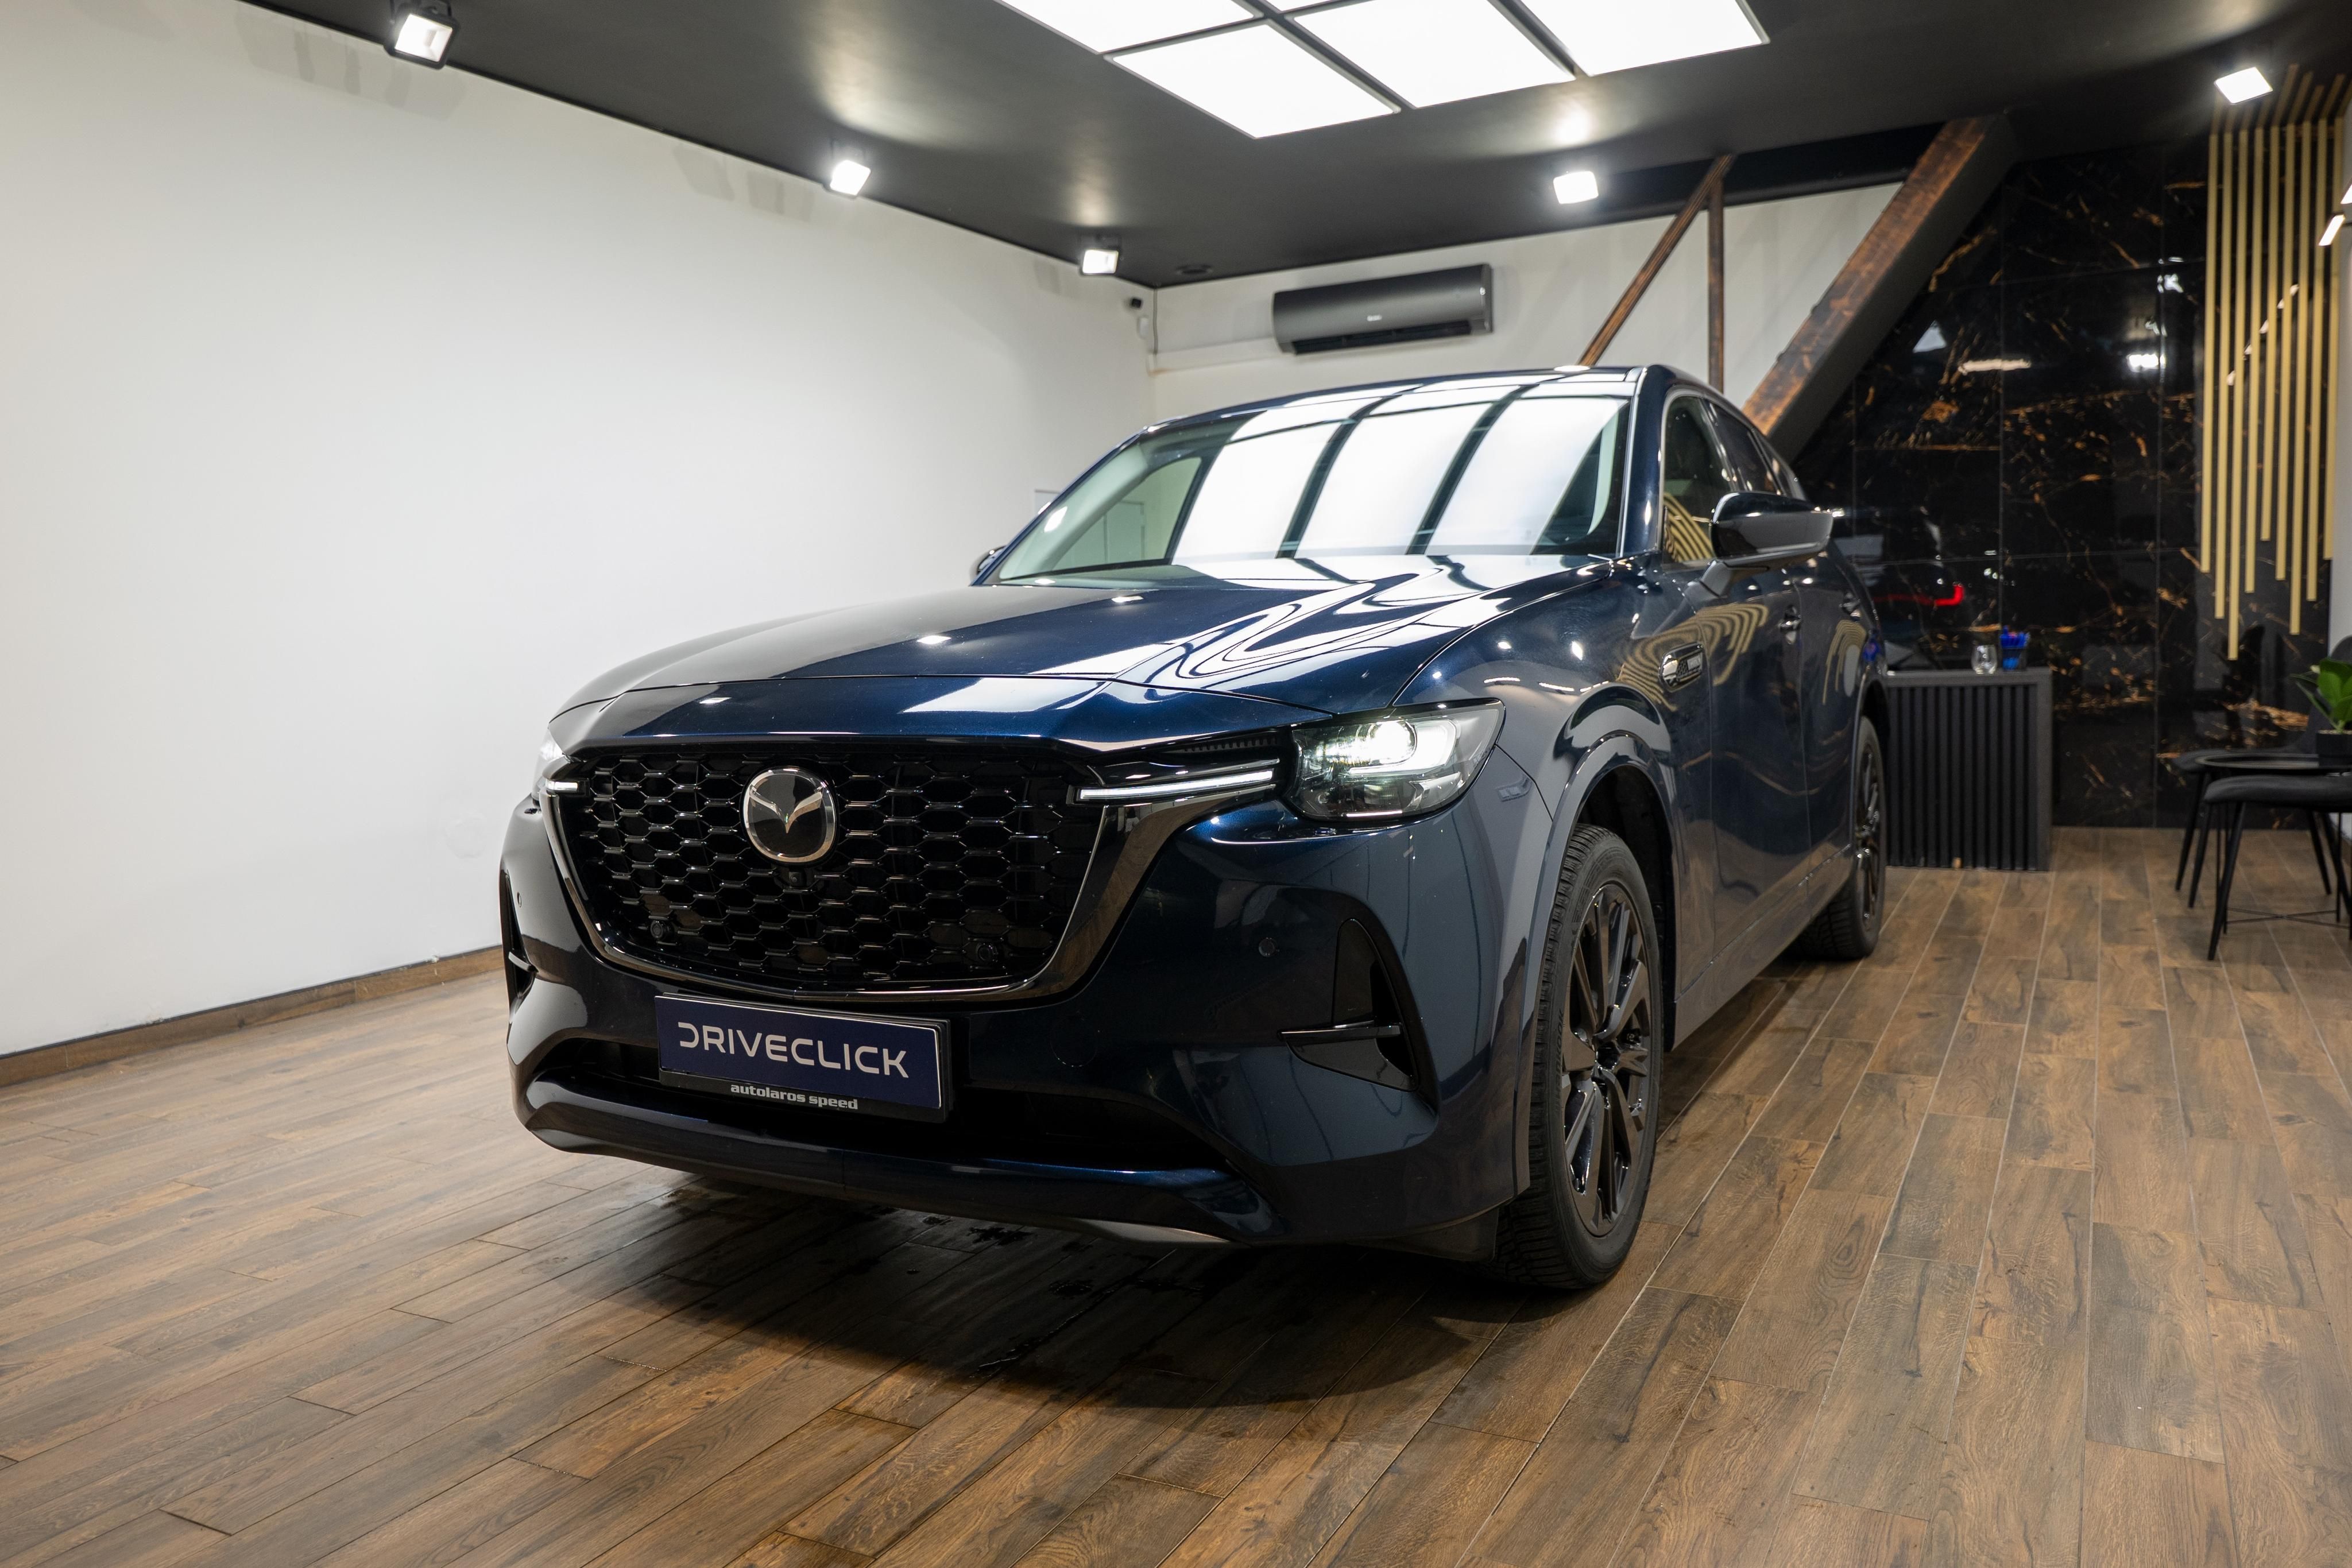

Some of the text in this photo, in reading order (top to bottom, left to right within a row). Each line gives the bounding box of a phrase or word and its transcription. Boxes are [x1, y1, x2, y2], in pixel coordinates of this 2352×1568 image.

[678, 1021, 909, 1078] DRIVECLICK
[730, 1084, 858, 1110] autolaros speed
